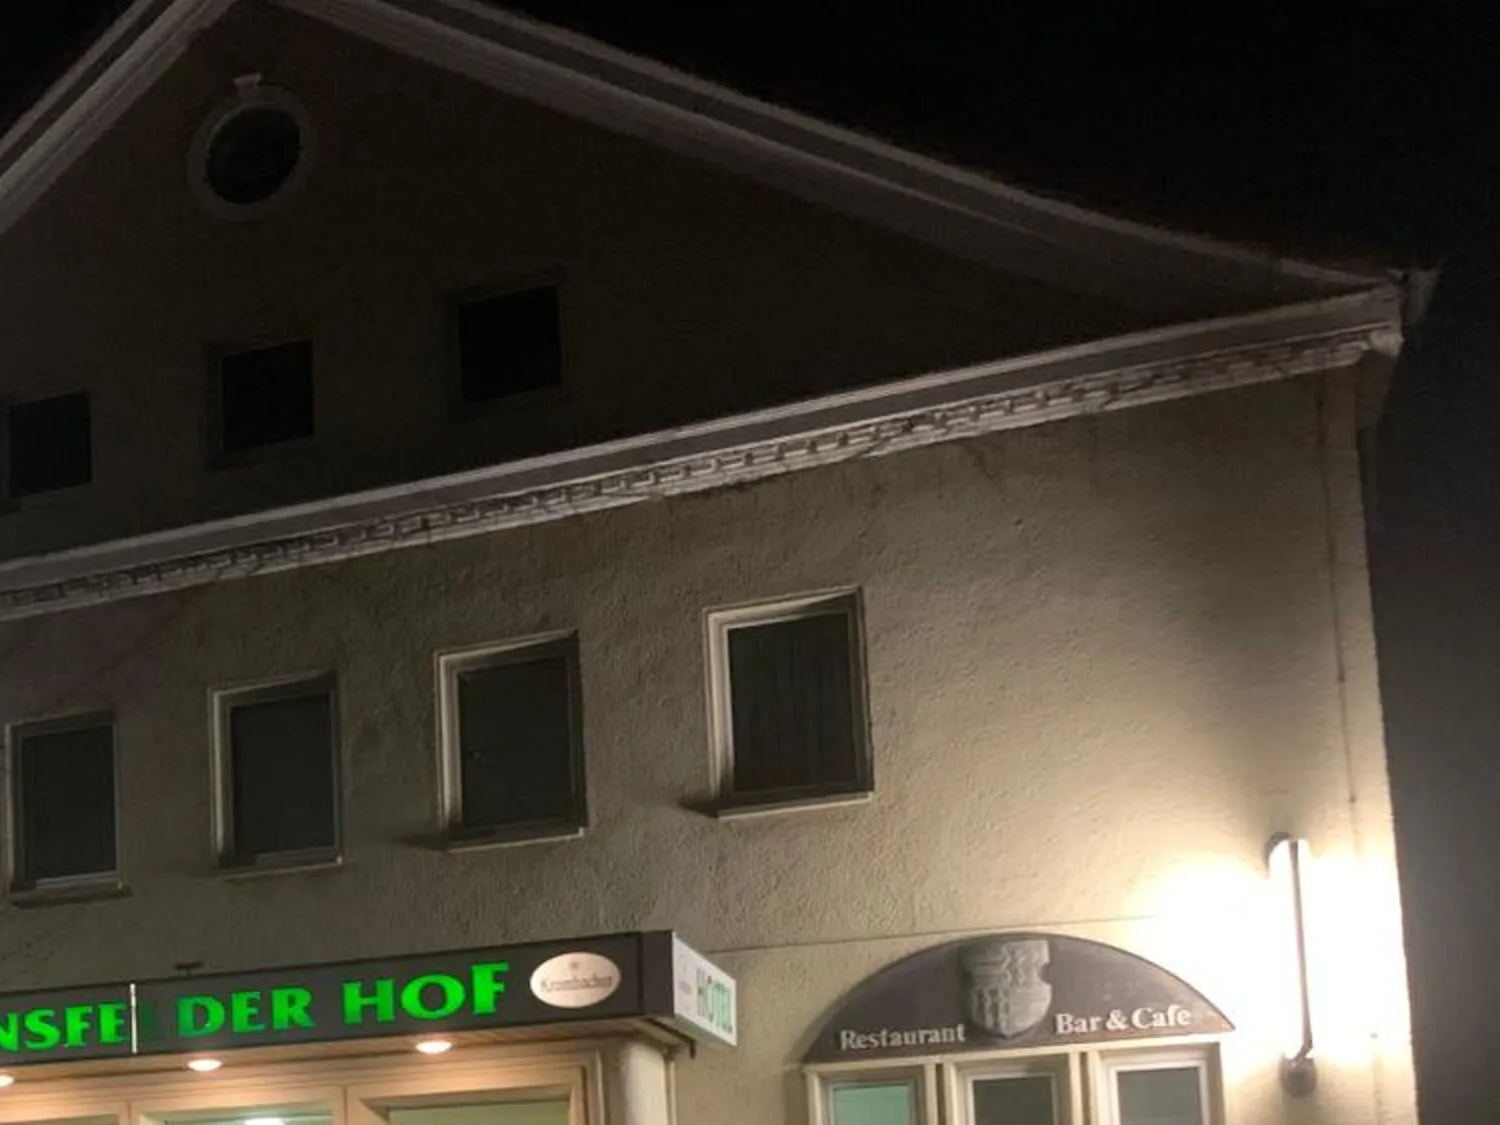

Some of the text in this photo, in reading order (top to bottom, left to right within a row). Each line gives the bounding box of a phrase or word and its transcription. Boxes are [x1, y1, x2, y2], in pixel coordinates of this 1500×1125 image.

[340, 960, 510, 1026] HOF
[1055, 1003, 1193, 1036] Bar & Cafe
[839, 1022, 967, 1051] Restaurant
